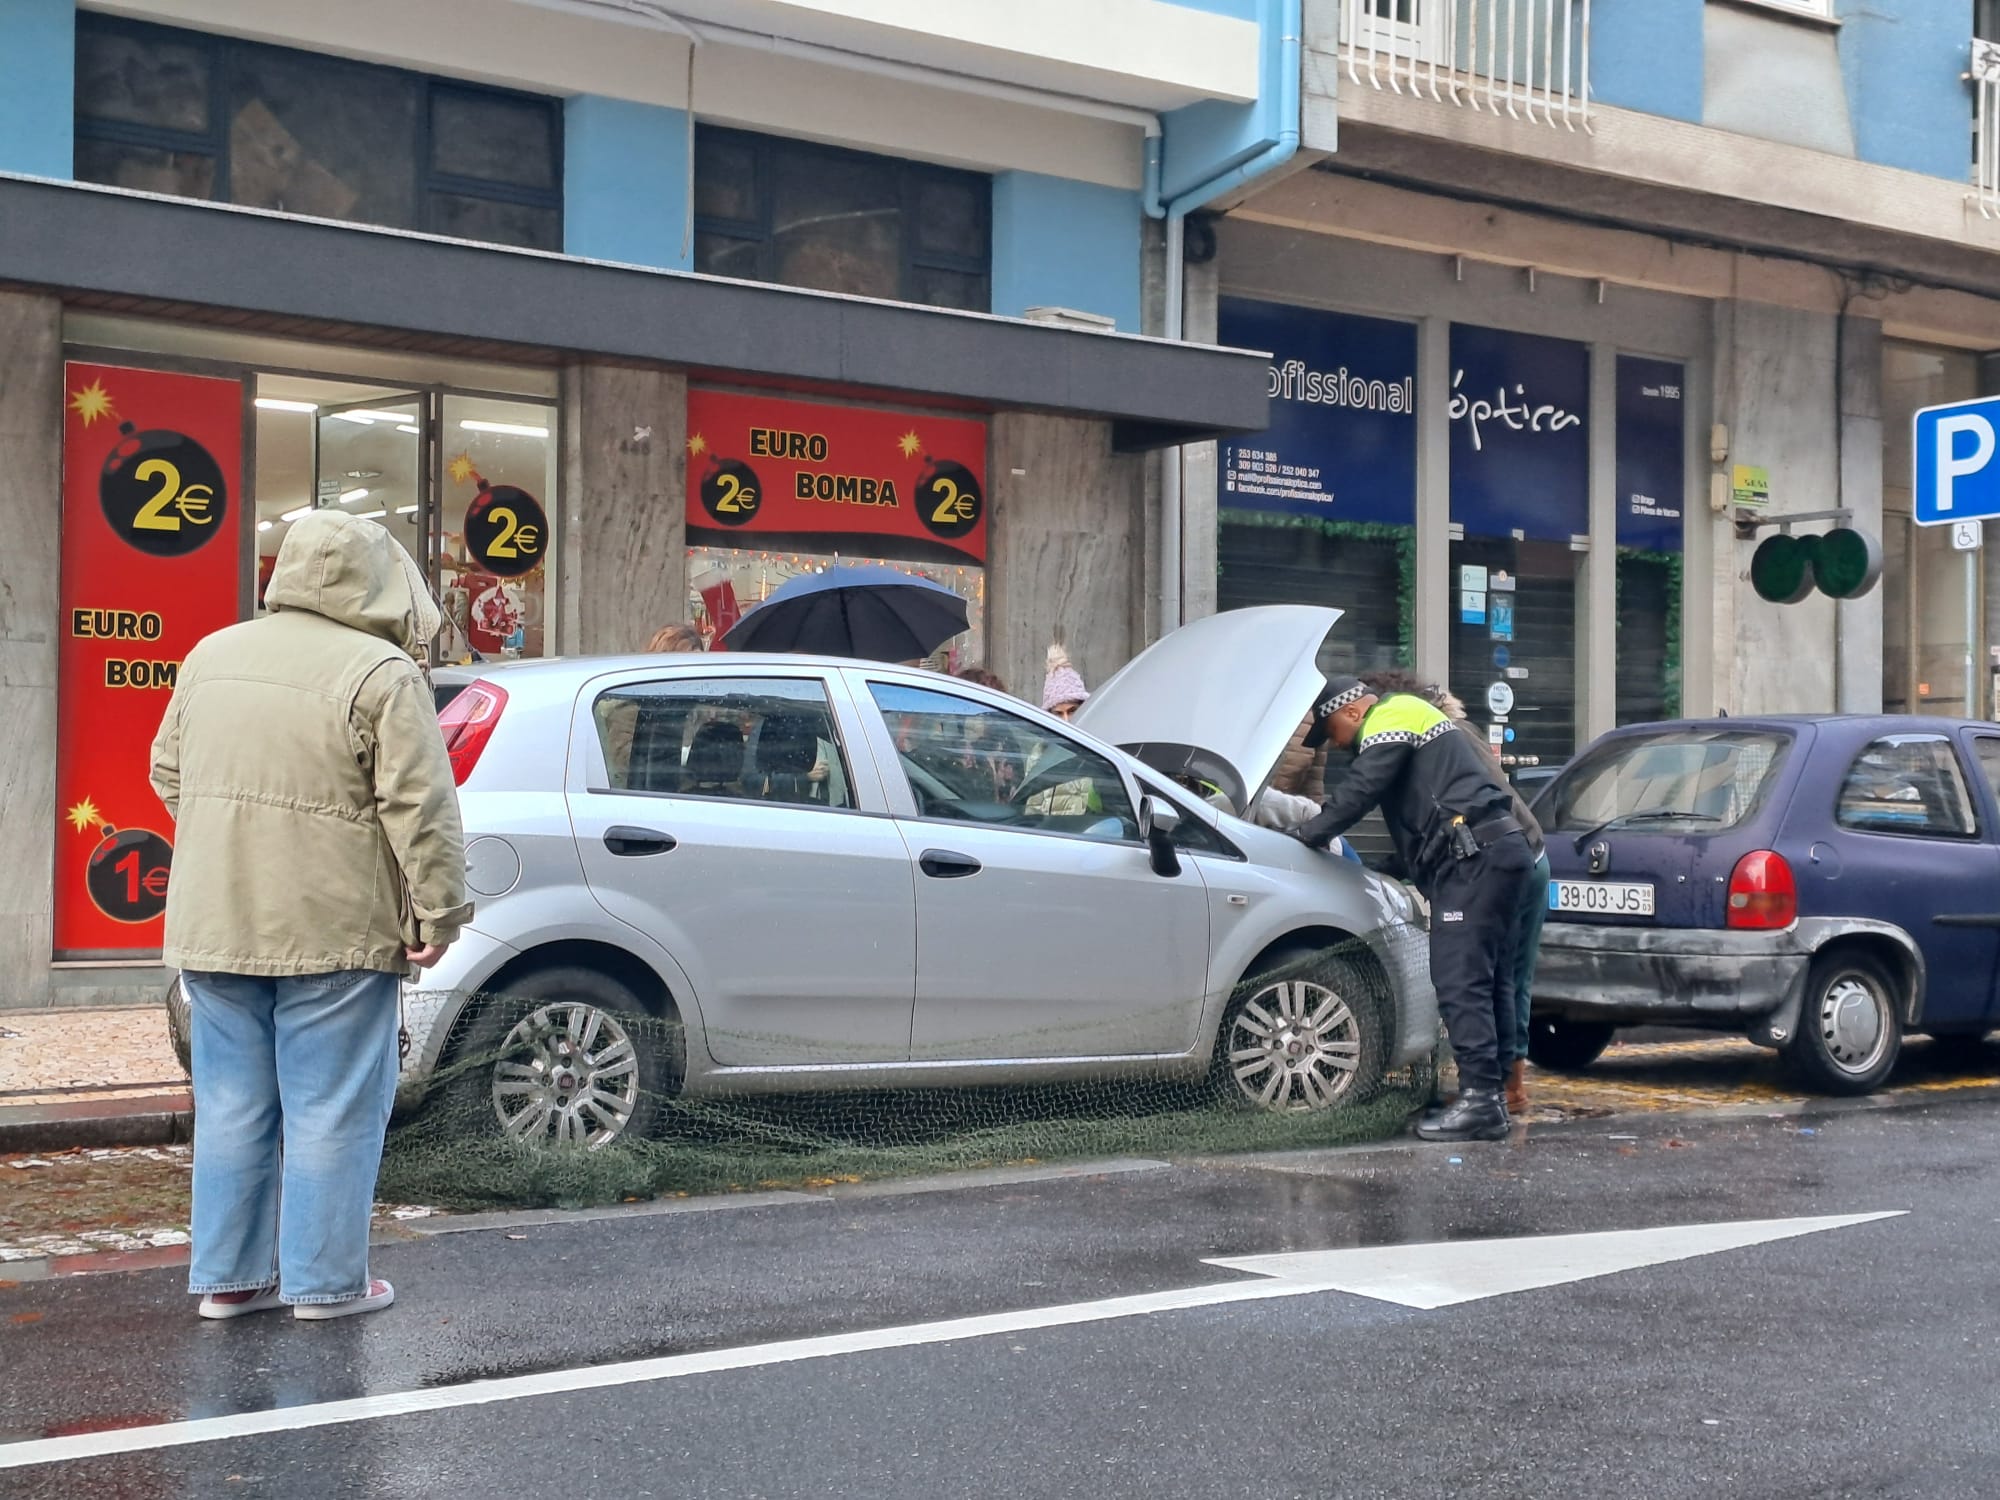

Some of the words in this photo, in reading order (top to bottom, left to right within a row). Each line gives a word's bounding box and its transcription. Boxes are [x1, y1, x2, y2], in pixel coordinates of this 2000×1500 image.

[1449, 369, 1580, 451] óptica
[749, 427, 828, 461] EURO
[1936, 413, 1995, 511] P
[132, 459, 213, 531] 2€
[715, 473, 756, 513] 2€
[795, 471, 899, 508] BOMBA
[931, 477, 976, 523] 2€
[485, 507, 539, 559] 2€
[72, 608, 162, 641] EURO
[105, 658, 183, 689] BOM
